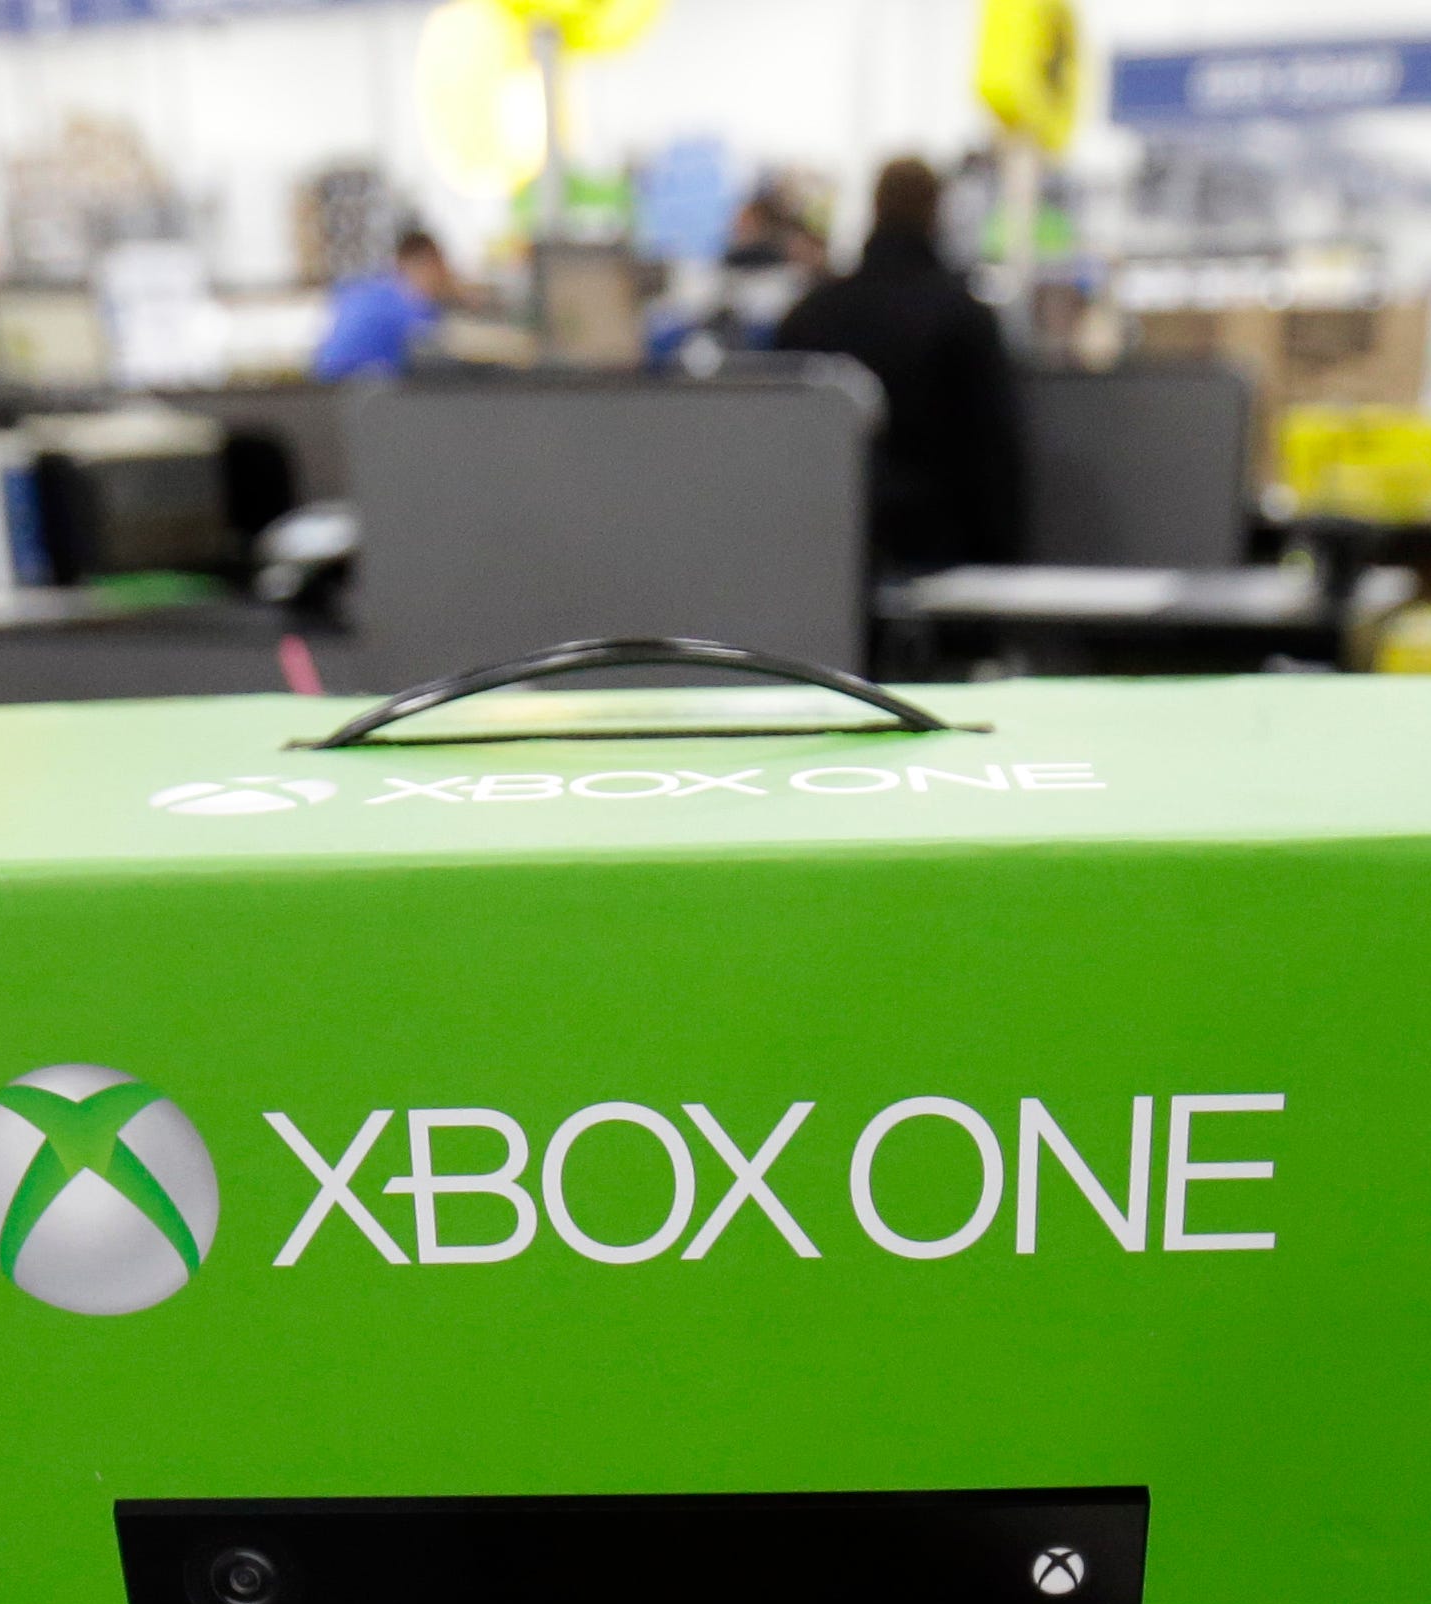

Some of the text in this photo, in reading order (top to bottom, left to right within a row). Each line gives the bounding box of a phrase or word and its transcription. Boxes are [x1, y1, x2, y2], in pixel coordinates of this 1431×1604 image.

[364, 763, 1107, 803] XBOX ONE
[262, 1092, 1286, 1267] XBOX ONE
